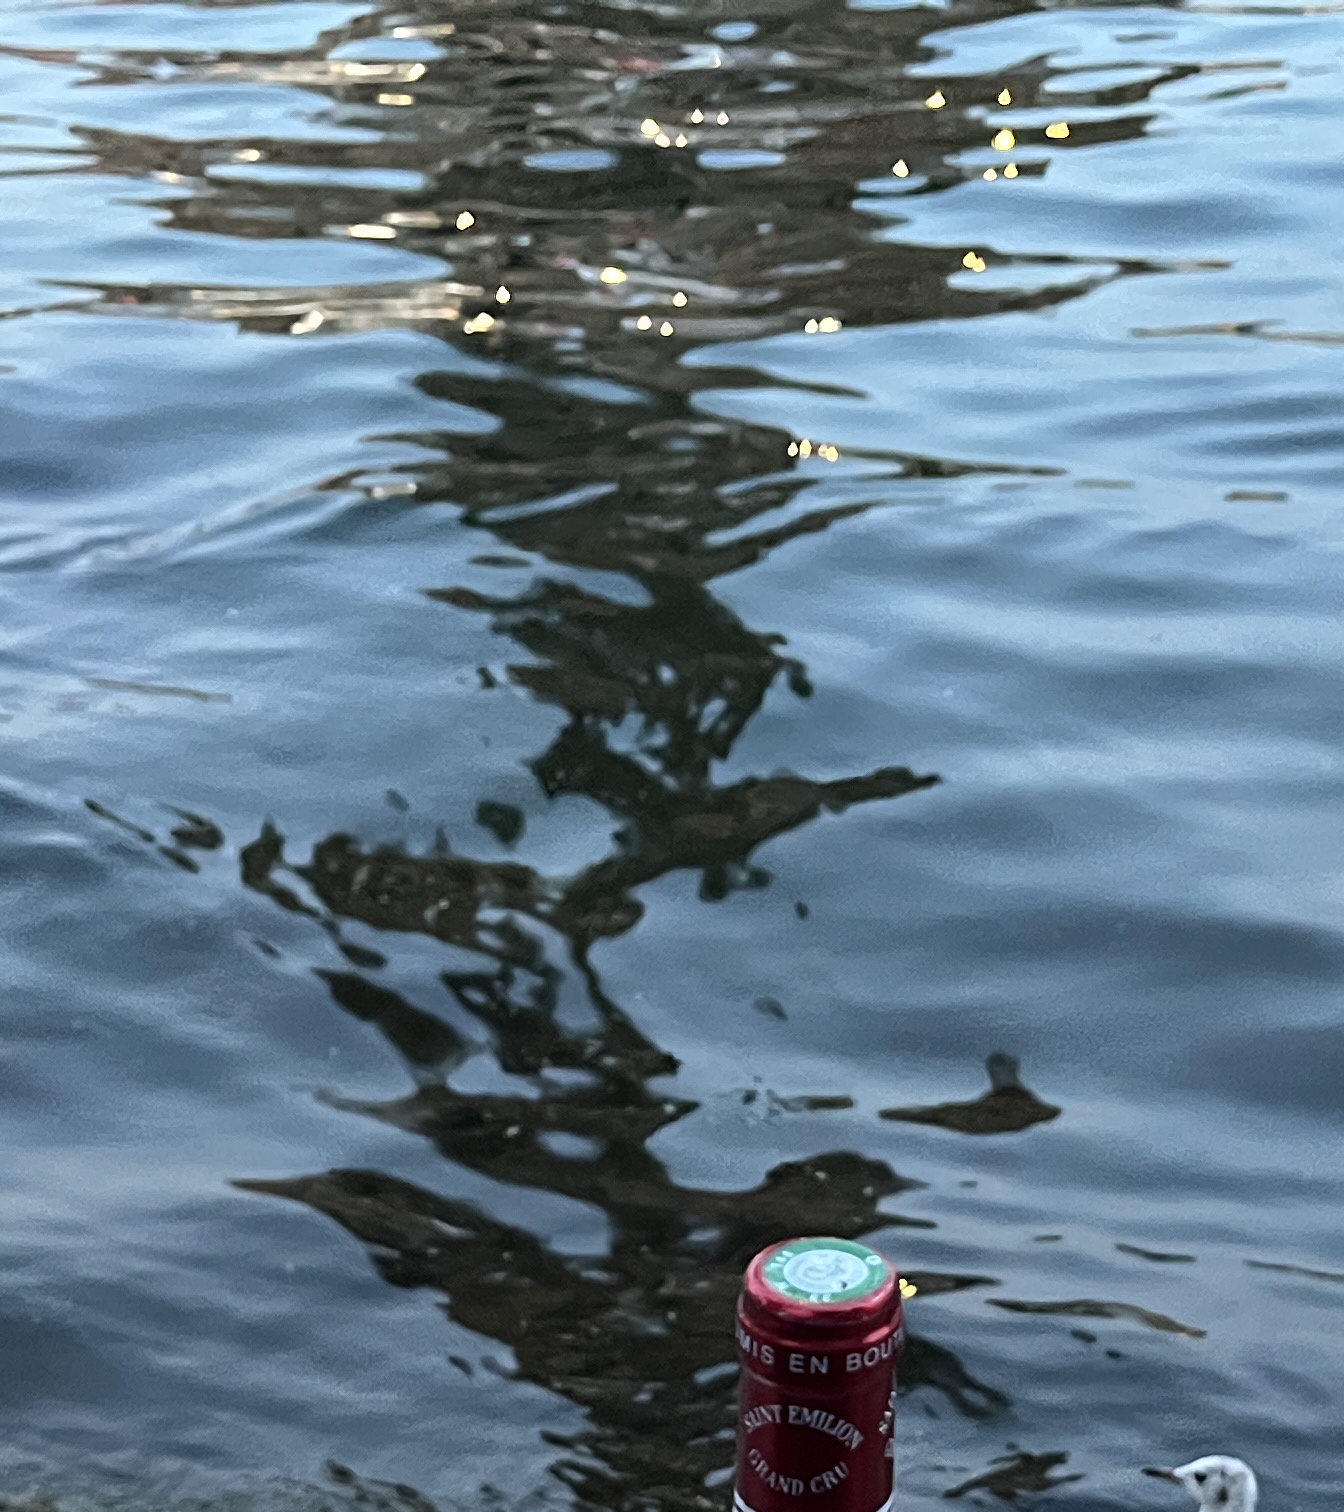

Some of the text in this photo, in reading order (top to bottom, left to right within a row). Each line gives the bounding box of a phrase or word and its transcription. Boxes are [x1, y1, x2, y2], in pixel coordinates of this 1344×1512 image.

[788, 1353, 829, 1375] EN
[743, 1404, 783, 1433] SAINT
[787, 1404, 865, 1451] EMILION
[748, 1448, 850, 1496] GRAND CRU
